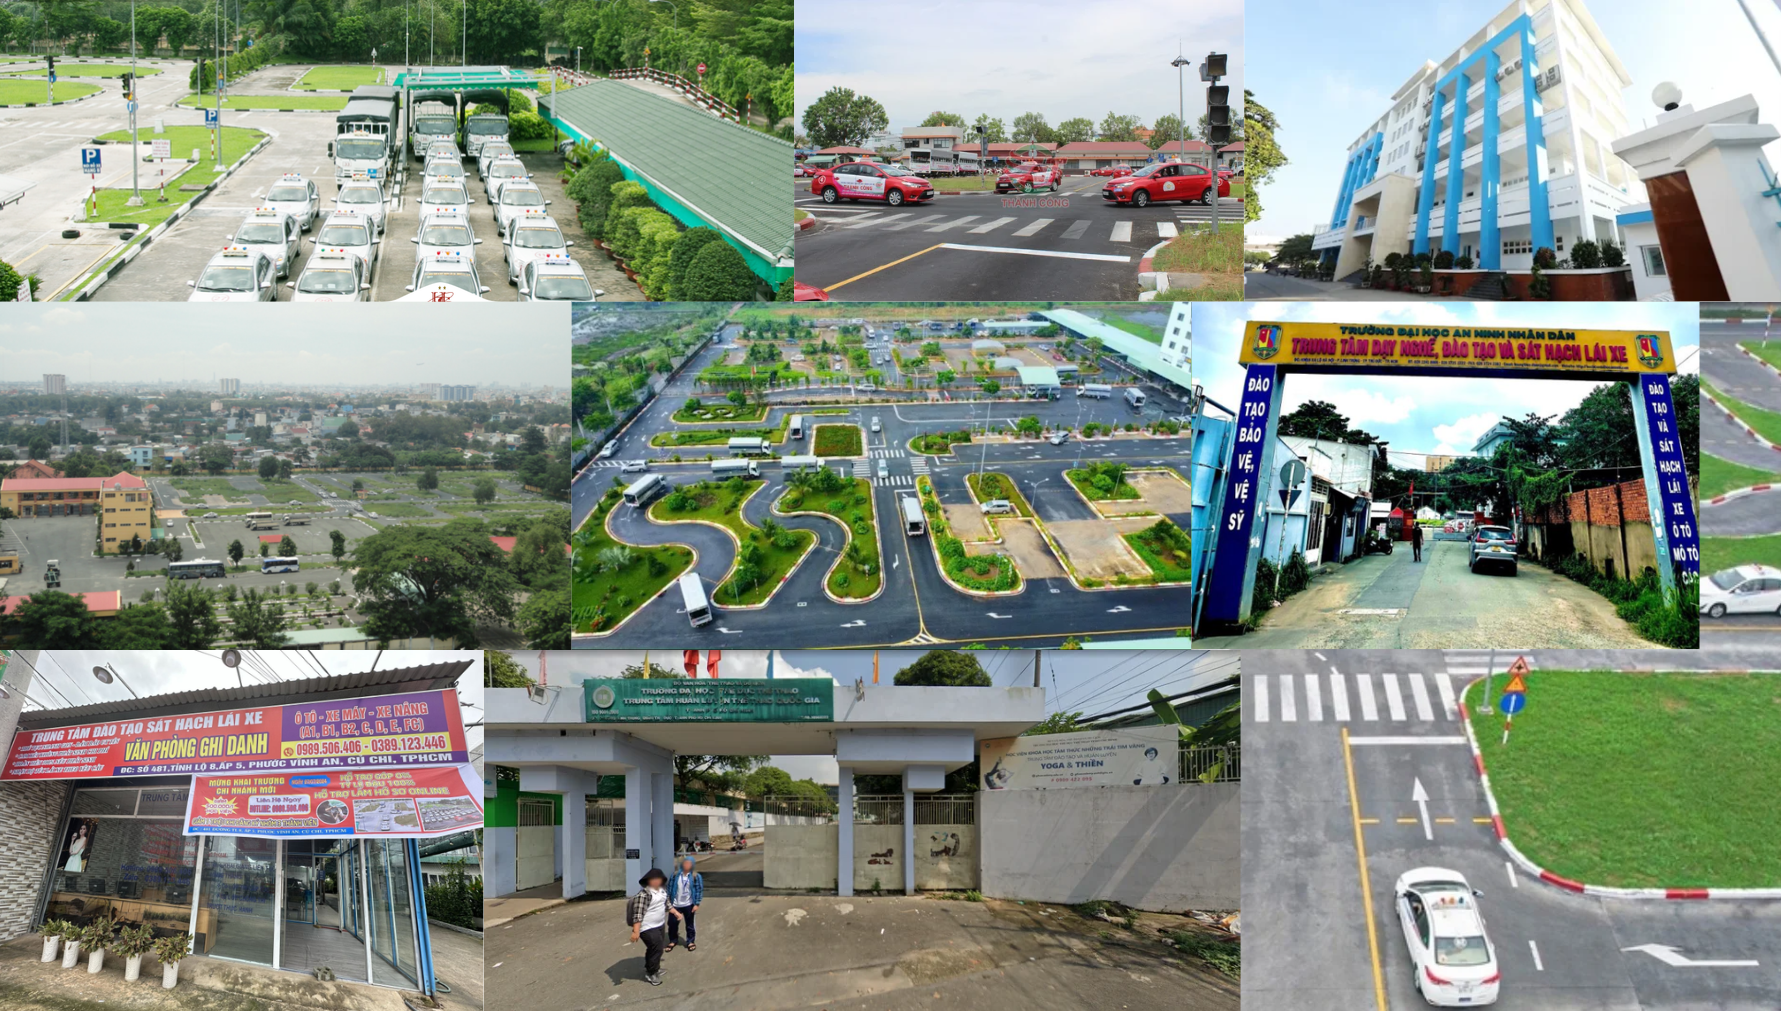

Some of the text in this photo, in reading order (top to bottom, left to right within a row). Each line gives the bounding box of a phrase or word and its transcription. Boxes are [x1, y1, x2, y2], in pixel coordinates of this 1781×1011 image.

[86, 149, 97, 163] P
[1340, 324, 1575, 340] TRƯỜNG ĐẠI HỌC AN NINH NHÂN DÂN
[1292, 338, 1337, 355] TRUNG
[1340, 336, 1369, 356] TÂM
[1372, 339, 1397, 359] DẠY
[1442, 338, 1469, 358] ĐÀO
[1472, 342, 1496, 361] TẠO
[1499, 338, 1515, 360] VÀ
[1518, 340, 1543, 360] SÁT
[1545, 344, 1582, 364] HẠCH
[1586, 342, 1607, 362] LÁI
[1609, 345, 1628, 363] XE
[1248, 374, 1270, 392] ĐÀO
[1648, 381, 1664, 395] ĐÀO
[1245, 402, 1266, 420] TẠO
[1651, 402, 1668, 416] TẠO
[1239, 422, 1262, 443] BẢO
[1657, 419, 1669, 433] VÀ
[1659, 437, 1674, 452] SÁT
[1238, 450, 1254, 473] VỆ,
[1659, 461, 1682, 476] HẠCH
[1234, 479, 1249, 503] VỆ
[1667, 478, 1682, 493] LÁI
[1672, 502, 1684, 515] XE
[1228, 510, 1245, 531] SỸ
[1672, 521, 1692, 538] Ô TÔ
[1673, 544, 1699, 561] MÔ TÔ
[641, 687, 677, 695] TRƯỜNG
[655, 696, 673, 704] TÂM
[675, 694, 700, 704] HUẤN
[295, 701, 428, 724] Ô TÔ XE MÁY XE NÂNG
[30, 711, 263, 743] TRUNG TÂM ĐÀO TẠO SÁT HẠCH LÁI XE
[300, 717, 425, 739] (A1, B1, B2, C, D, E, FC)
[124, 738, 151, 762] VĂN
[151, 735, 197, 760] PHÒNG
[200, 736, 224, 758] GHI
[226, 733, 268, 756] DANH
[296, 735, 446, 756] 0989.506.406 0389.123.446
[137, 764, 149, 773] SỐ
[194, 761, 207, 772] LỘ
[249, 759, 287, 769] PHƯỚC
[290, 757, 318, 767] VĨNH
[347, 754, 365, 765] CỦ
[401, 753, 453, 763] TPHCM
[1041, 762, 1065, 770] YOGA
[1075, 758, 1104, 768] THIỀN
[208, 777, 285, 787] MỪNG KHAI TRƯƠNG
[354, 773, 373, 782] TRỢ
[374, 771, 394, 780] GÓP
[388, 778, 415, 787] 100%
[216, 784, 276, 795] CHI NHÁNH MỚI
[329, 789, 349, 799] TRỢ
[391, 786, 407, 796] SƠ
[408, 786, 450, 796] ONLINE
[141, 793, 169, 802] TRUNG
